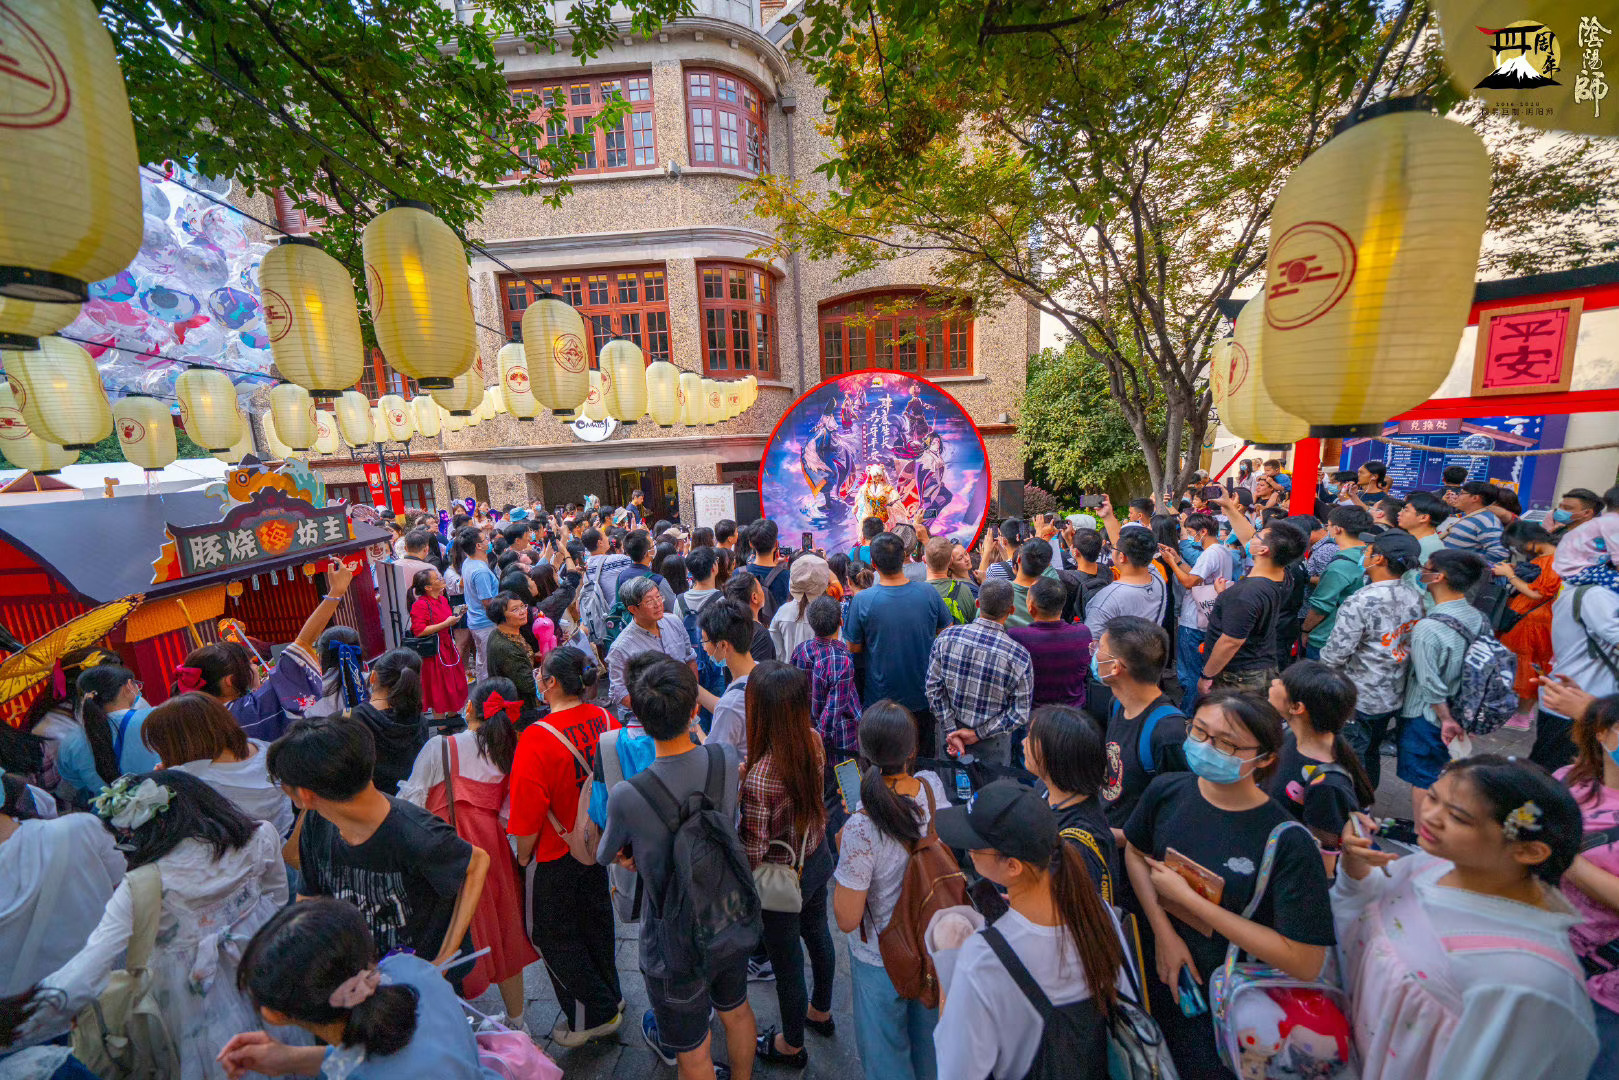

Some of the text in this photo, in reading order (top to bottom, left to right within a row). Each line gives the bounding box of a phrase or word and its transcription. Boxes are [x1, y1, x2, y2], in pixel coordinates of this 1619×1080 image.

[1494, 318, 1557, 380] 平安
[1410, 420, 1448, 431] 兑换处
